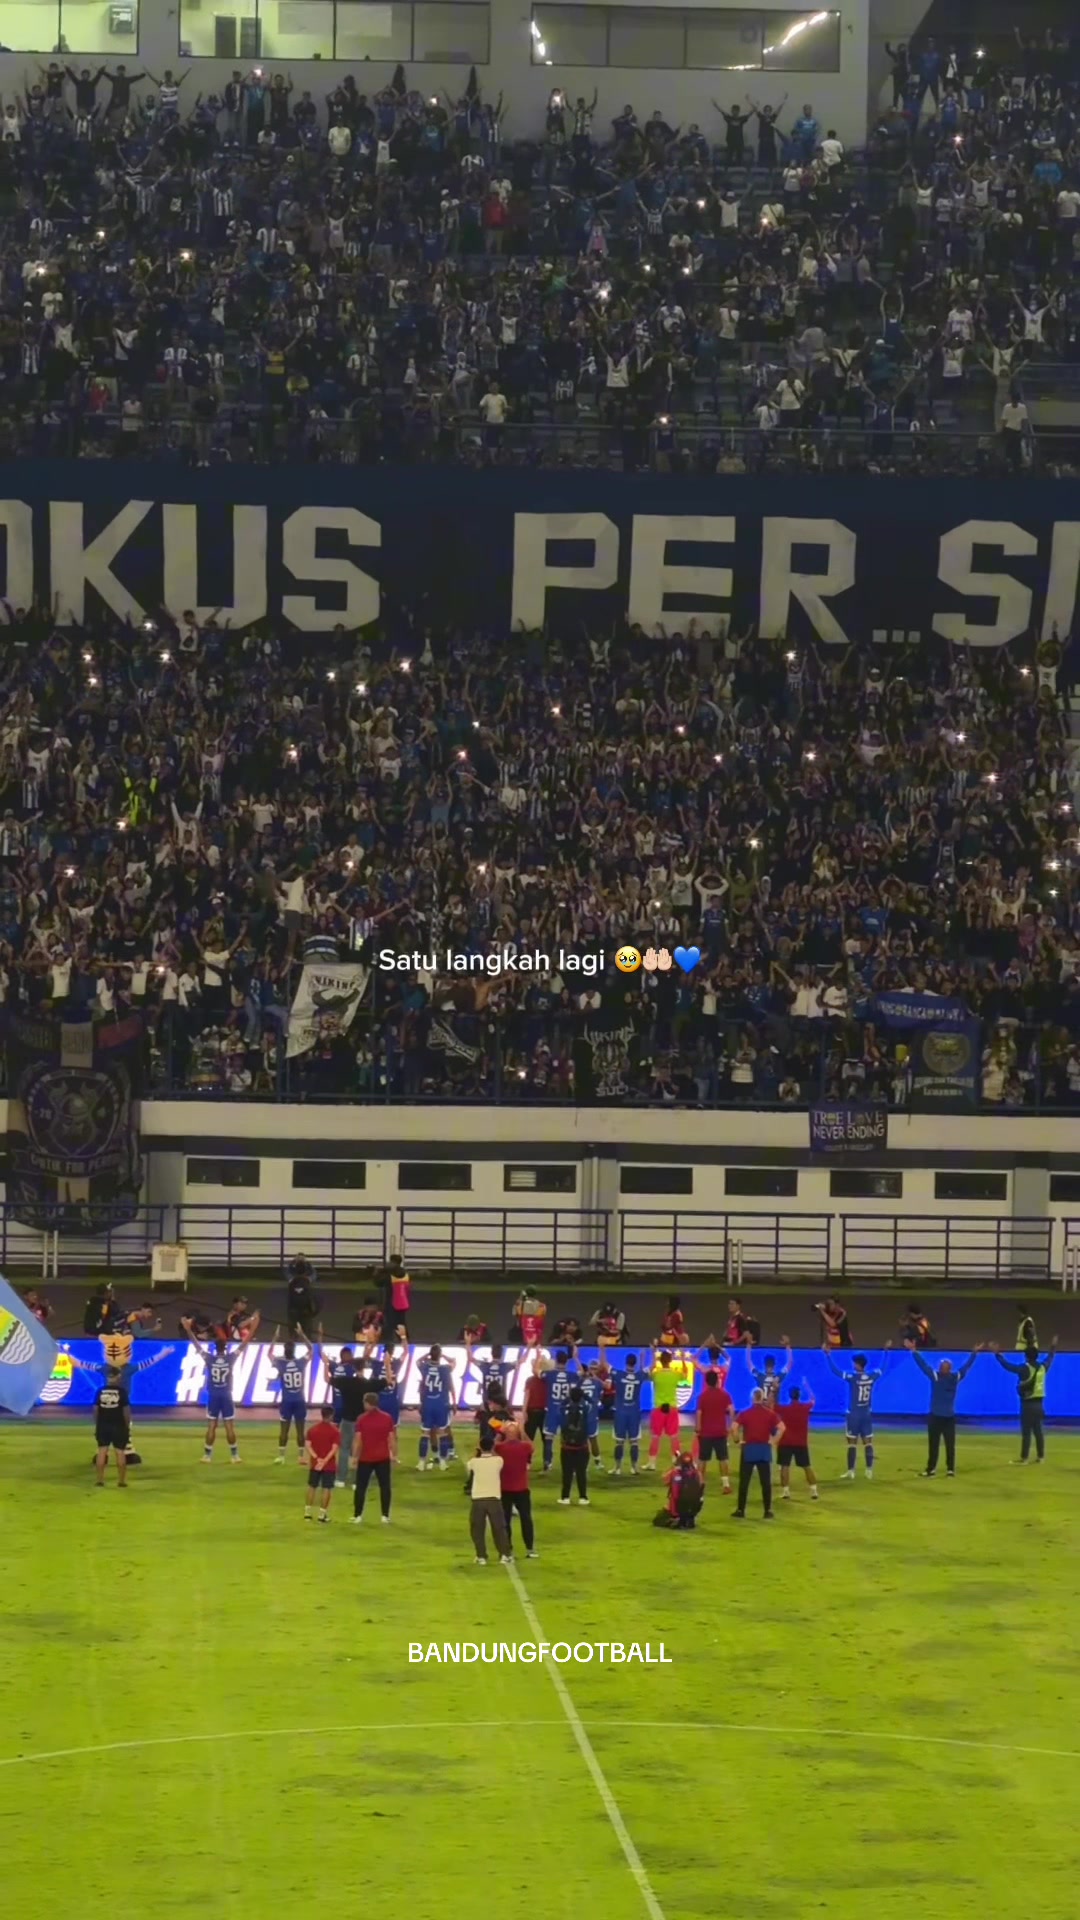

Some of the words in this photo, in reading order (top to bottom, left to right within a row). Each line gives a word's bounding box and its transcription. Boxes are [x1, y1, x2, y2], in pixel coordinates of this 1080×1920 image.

[813, 1124, 845, 1140] NEVER
[847, 1123, 886, 1140] ENDING
[211, 1367, 229, 1383] 97
[283, 1372, 302, 1388] 98
[424, 1374, 442, 1392] 44
[552, 1383, 569, 1400] 93
[624, 1384, 634, 1400] 8
[858, 1386, 871, 1402] 16
